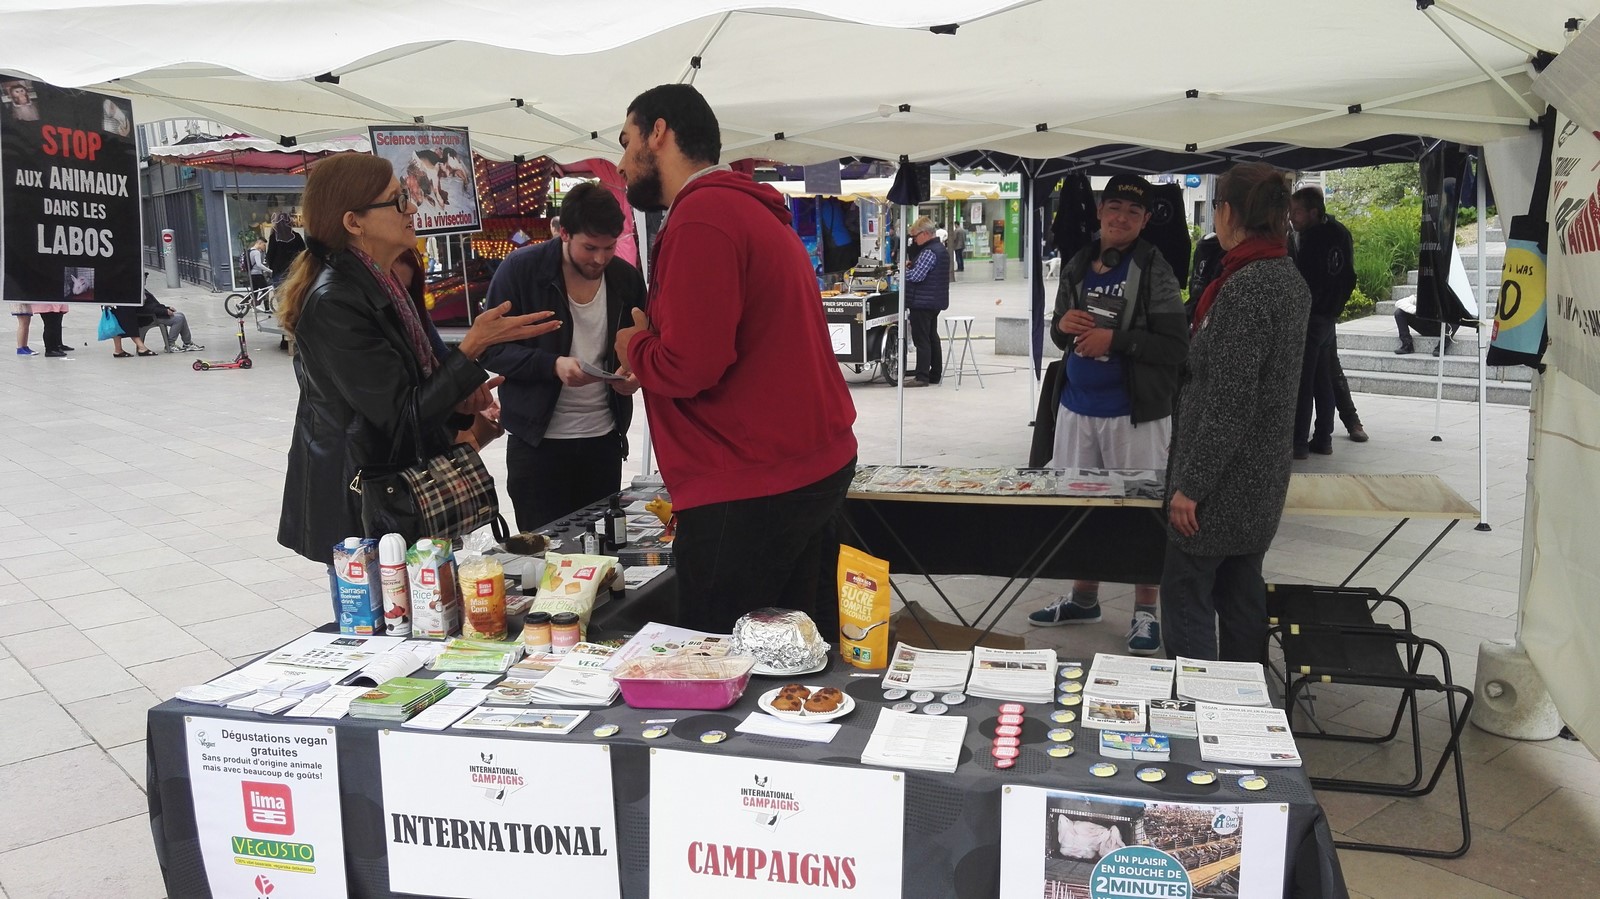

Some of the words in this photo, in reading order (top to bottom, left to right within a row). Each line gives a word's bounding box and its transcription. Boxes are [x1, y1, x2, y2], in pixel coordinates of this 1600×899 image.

[41, 125, 102, 160] STOP
[376, 132, 416, 145] Science
[417, 135, 429, 144] ou
[16, 169, 43, 188] AUX
[50, 166, 129, 198] ANIMAUX
[44, 198, 79, 217] DANS
[83, 202, 106, 219] LES
[417, 213, 422, 228] à
[425, 213, 432, 228] la
[434, 210, 472, 227] vivisection
[37, 224, 114, 258] LABOS
[1516, 264, 1534, 276] WAS
[340, 586, 366, 594] Sarrasin
[413, 590, 431, 599] Rice
[842, 586, 874, 607] SUCRE
[841, 598, 872, 615] COMPLET
[222, 729, 291, 744] Dégustations
[294, 736, 328, 747] vegan
[202, 753, 221, 762] Sans
[223, 756, 251, 765] produit
[253, 758, 287, 768] d'origine
[251, 747, 298, 758] gratuites
[203, 764, 221, 772] mais
[244, 767, 282, 778] beaucoup
[284, 770, 294, 778] de
[296, 771, 323, 780] goûts!
[469, 765, 518, 775] INTERNATIONAL
[472, 773, 524, 785] CAMPAIGNS
[250, 790, 286, 809] lima
[741, 788, 794, 800] INTERNATIONAL
[743, 796, 800, 811] CAMPAIGNS
[391, 813, 607, 856] INTERNATIONAL
[233, 836, 312, 860] VEGUSTO
[688, 840, 856, 890] CAMPAIGNS
[1114, 855, 1129, 864] UN
[1132, 856, 1167, 867] PLAISIR
[1102, 864, 1115, 874] EN
[1119, 866, 1164, 878] BOUCHE
[1168, 870, 1182, 879] DE
[1096, 876, 1108, 893] 2
[1111, 879, 1186, 897] MINUTES
